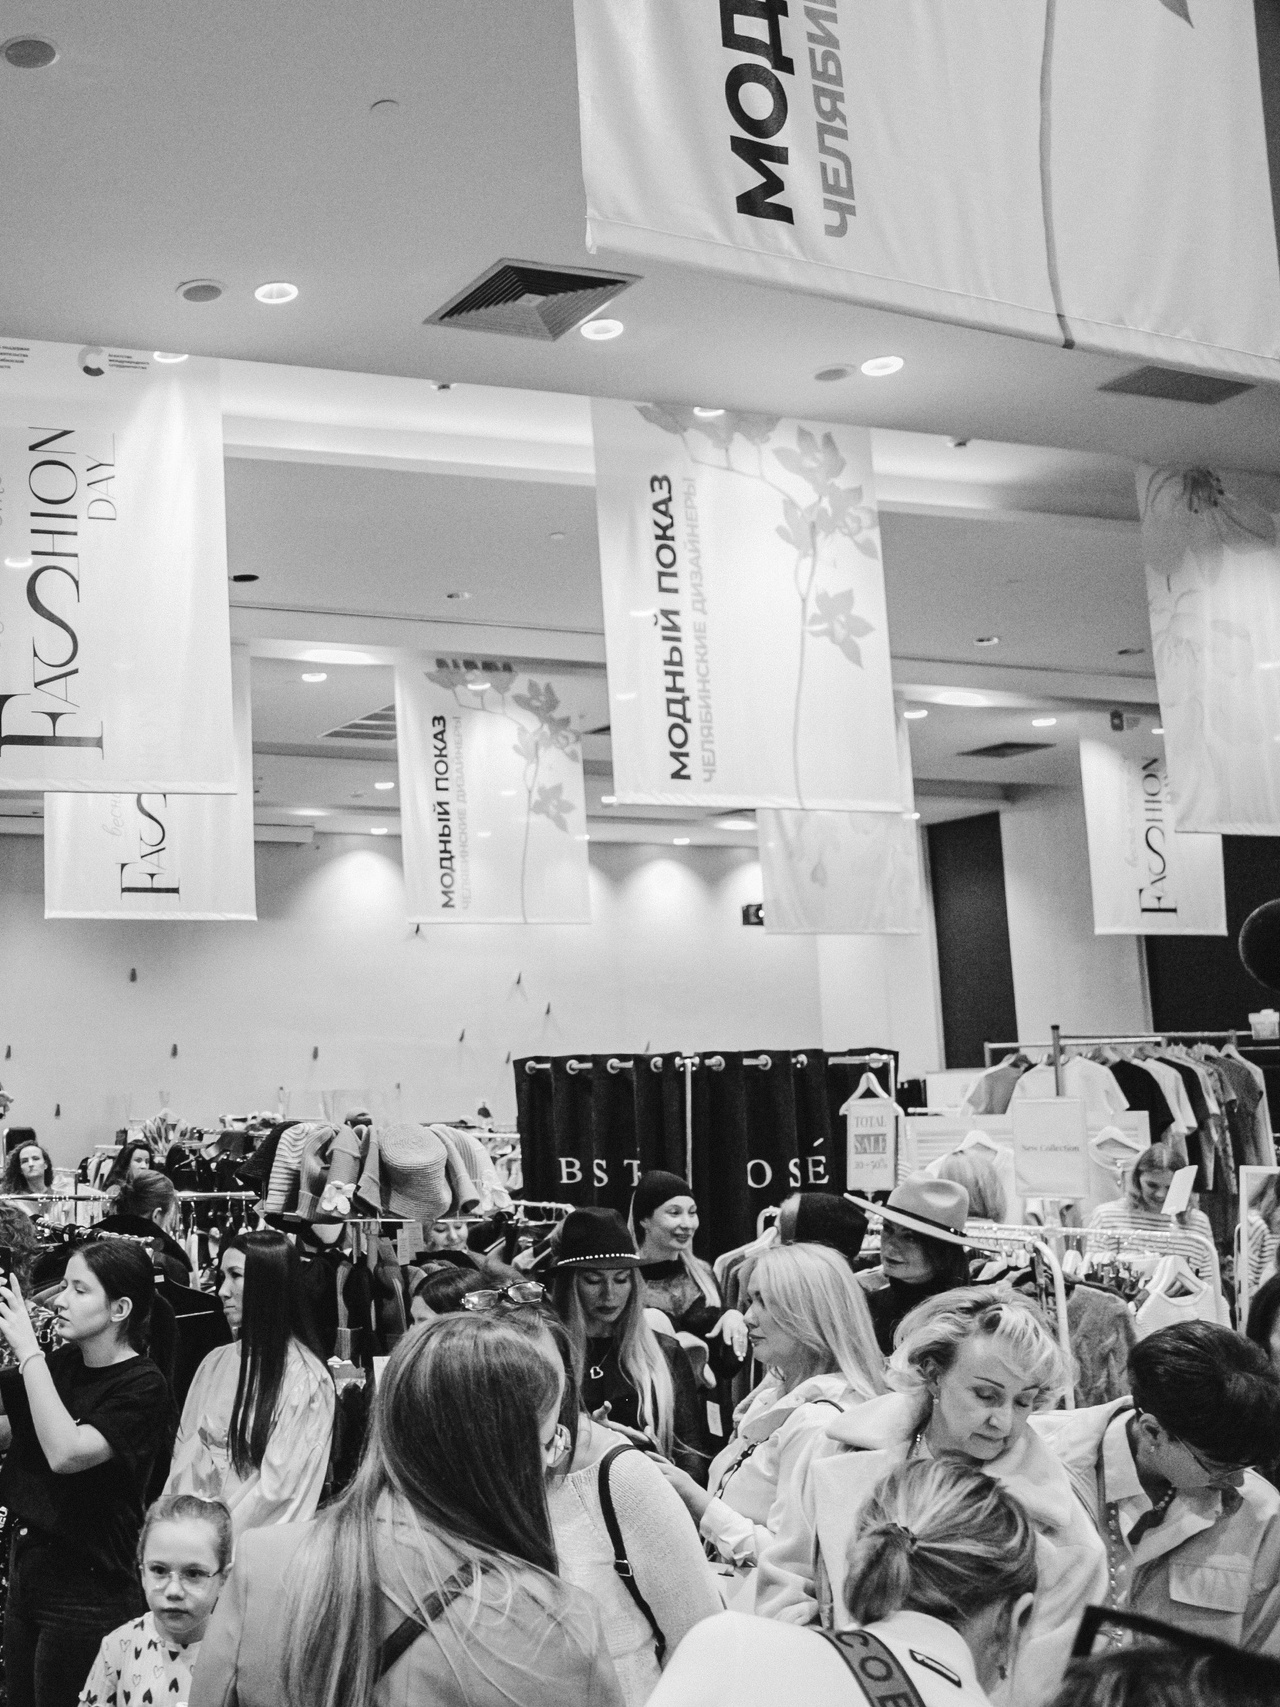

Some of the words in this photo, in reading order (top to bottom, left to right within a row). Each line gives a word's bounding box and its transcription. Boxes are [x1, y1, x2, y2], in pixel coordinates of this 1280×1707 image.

[86, 454, 117, 520] DAY
[650, 474, 679, 594] ПОКАЗ
[683, 476, 707, 615] ДИЗАЙНЕРЫ
[654, 608, 692, 780] МОДНЫЙ
[694, 621, 716, 783] ЧЕЛЯБИНСКИЕ
[432, 715, 450, 791] ПОКАЗ
[433, 801, 455, 909] МОДНЫЙ
[1139, 756, 1178, 917] FASHION
[854, 1115, 886, 1128] TOTAL
[854, 1134, 887, 1153] SALE
